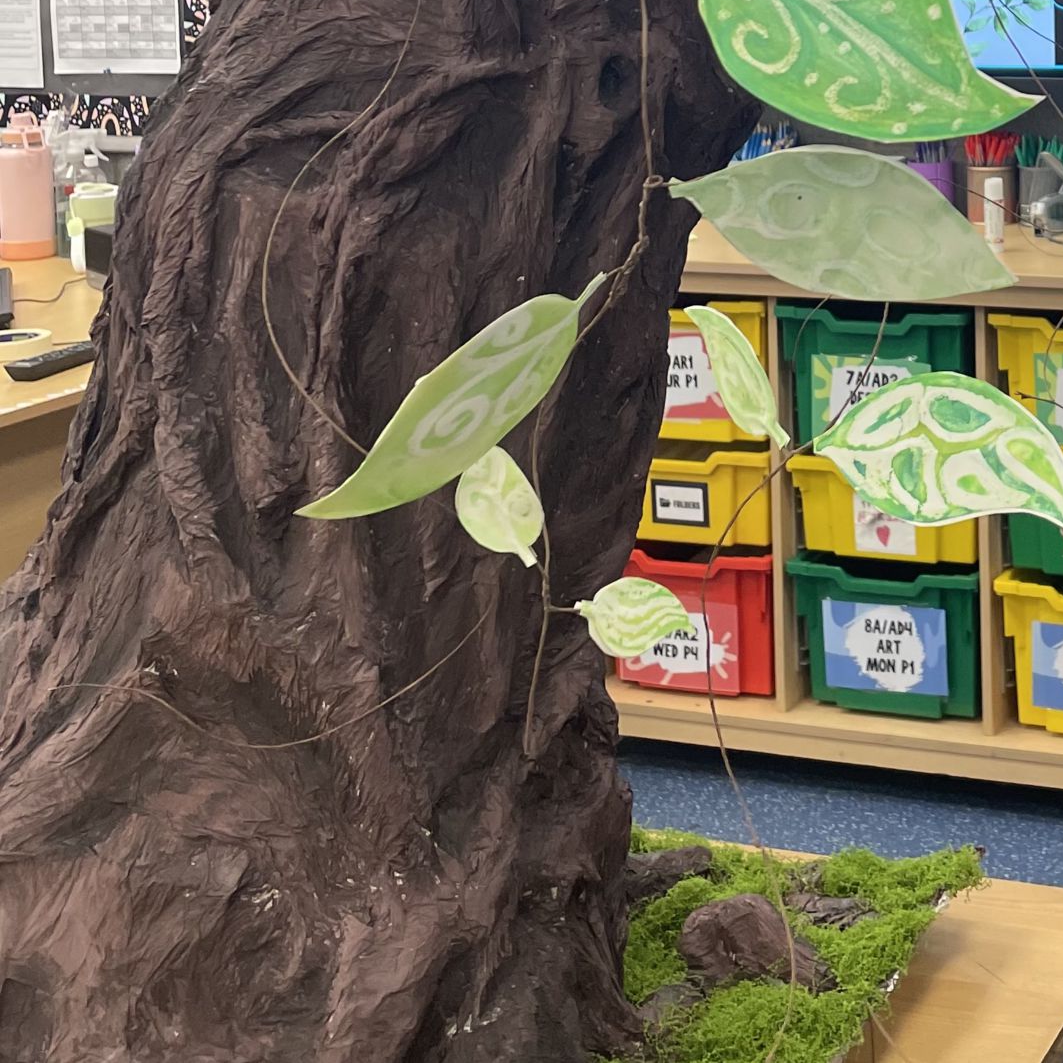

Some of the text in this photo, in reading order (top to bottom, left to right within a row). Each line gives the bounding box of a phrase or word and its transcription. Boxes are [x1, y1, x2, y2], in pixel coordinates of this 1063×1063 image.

[672, 355, 694, 369] AR1
[667, 373, 698, 388] UR P1
[864, 618, 913, 636] 8A/AD4
[653, 642, 698, 660] WED P4
[876, 639, 901, 655] ART
[866, 657, 915, 675] MON P1
